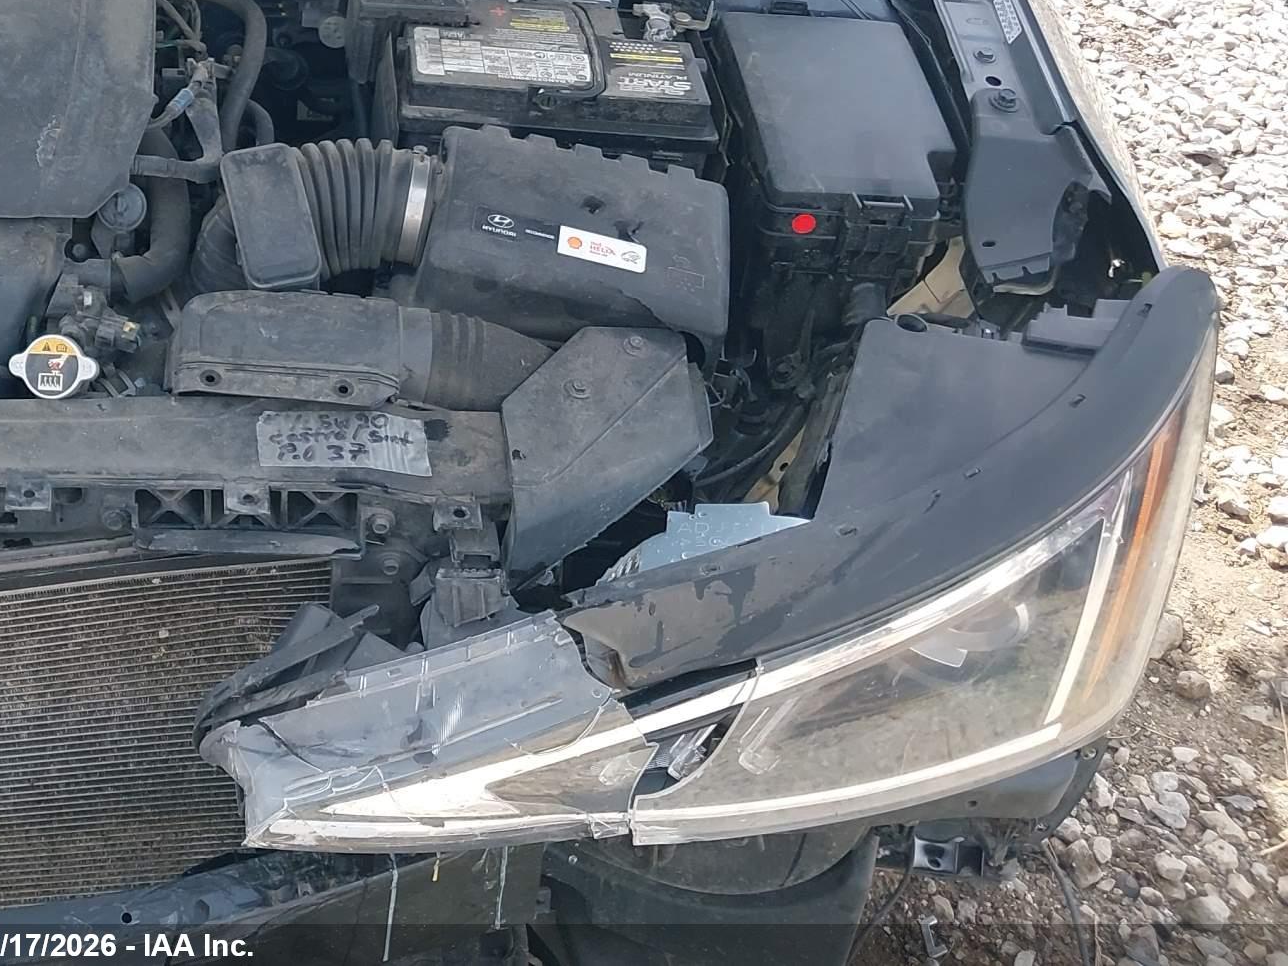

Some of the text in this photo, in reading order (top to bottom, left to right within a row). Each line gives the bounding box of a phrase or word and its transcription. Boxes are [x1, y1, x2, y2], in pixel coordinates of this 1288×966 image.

[628, 72, 688, 80] PLATINUM
[617, 77, 692, 91] START
[619, 85, 685, 96] SUPER
[481, 224, 517, 238] HYUNDAI
